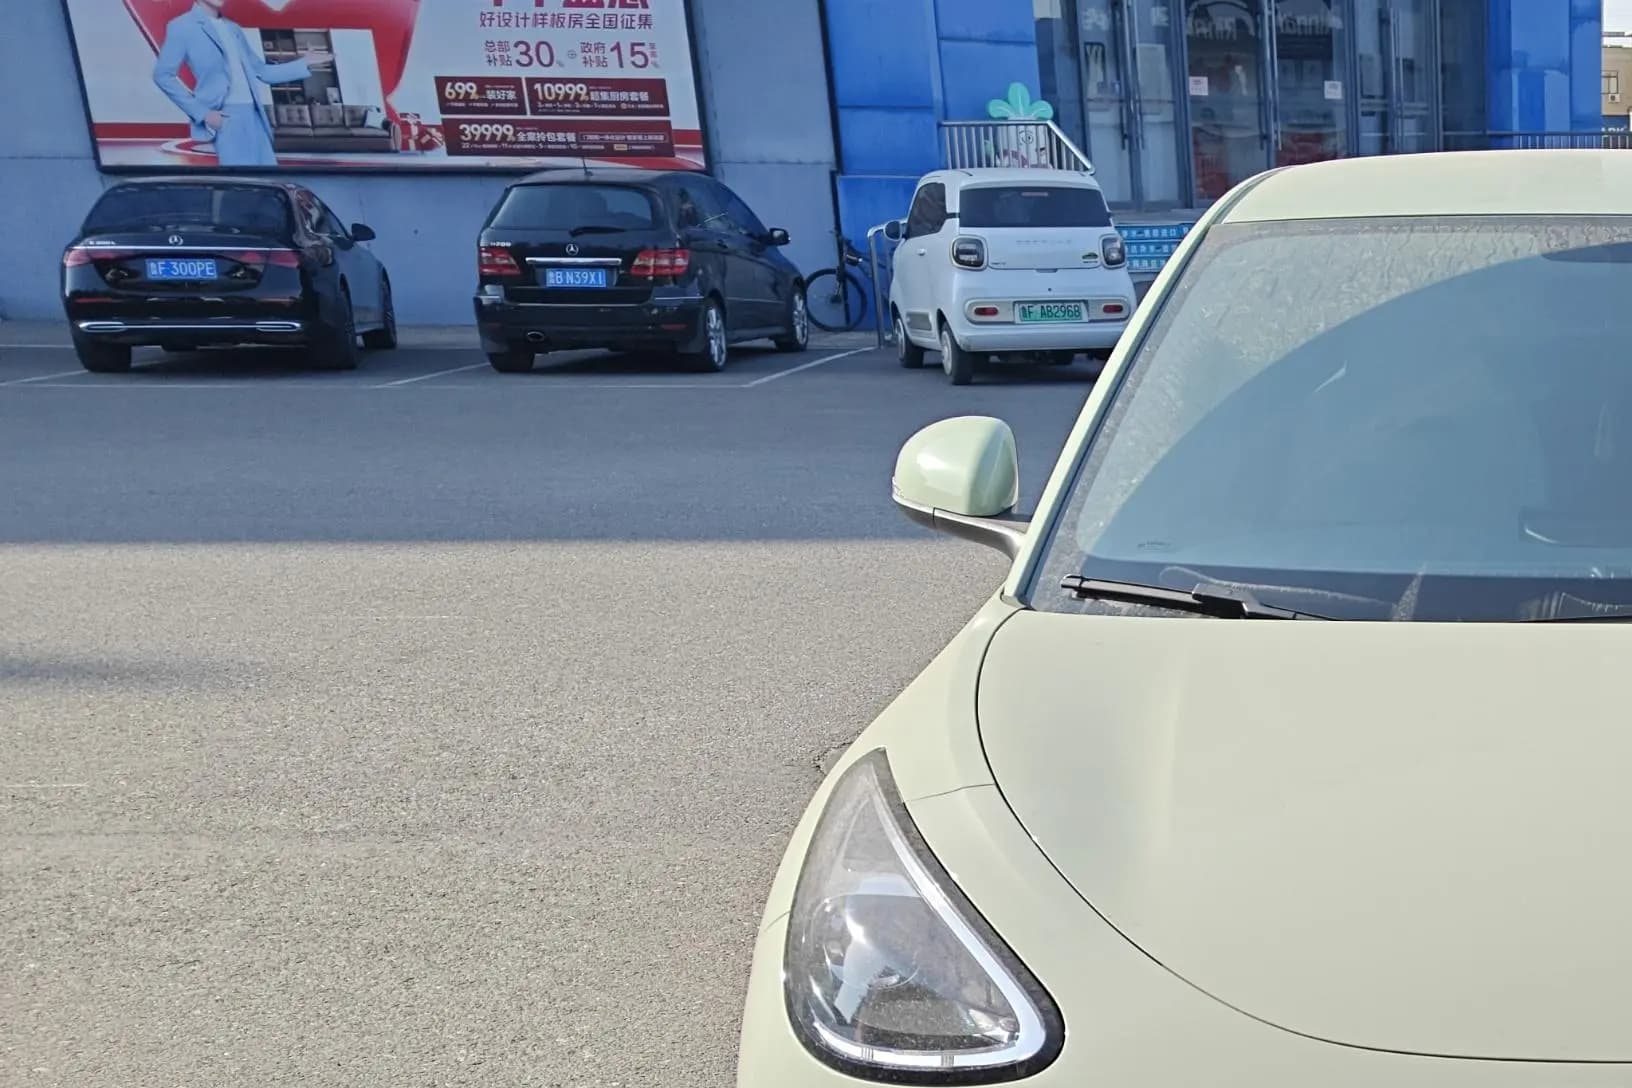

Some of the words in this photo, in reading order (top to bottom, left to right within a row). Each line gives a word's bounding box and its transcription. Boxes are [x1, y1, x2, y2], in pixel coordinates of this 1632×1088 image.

[479, 11, 654, 31] 好设计样板房全国征集
[484, 40, 511, 53] 总部
[580, 41, 606, 55] 政府
[486, 54, 513, 67] 补贴
[582, 55, 609, 68] 补贴
